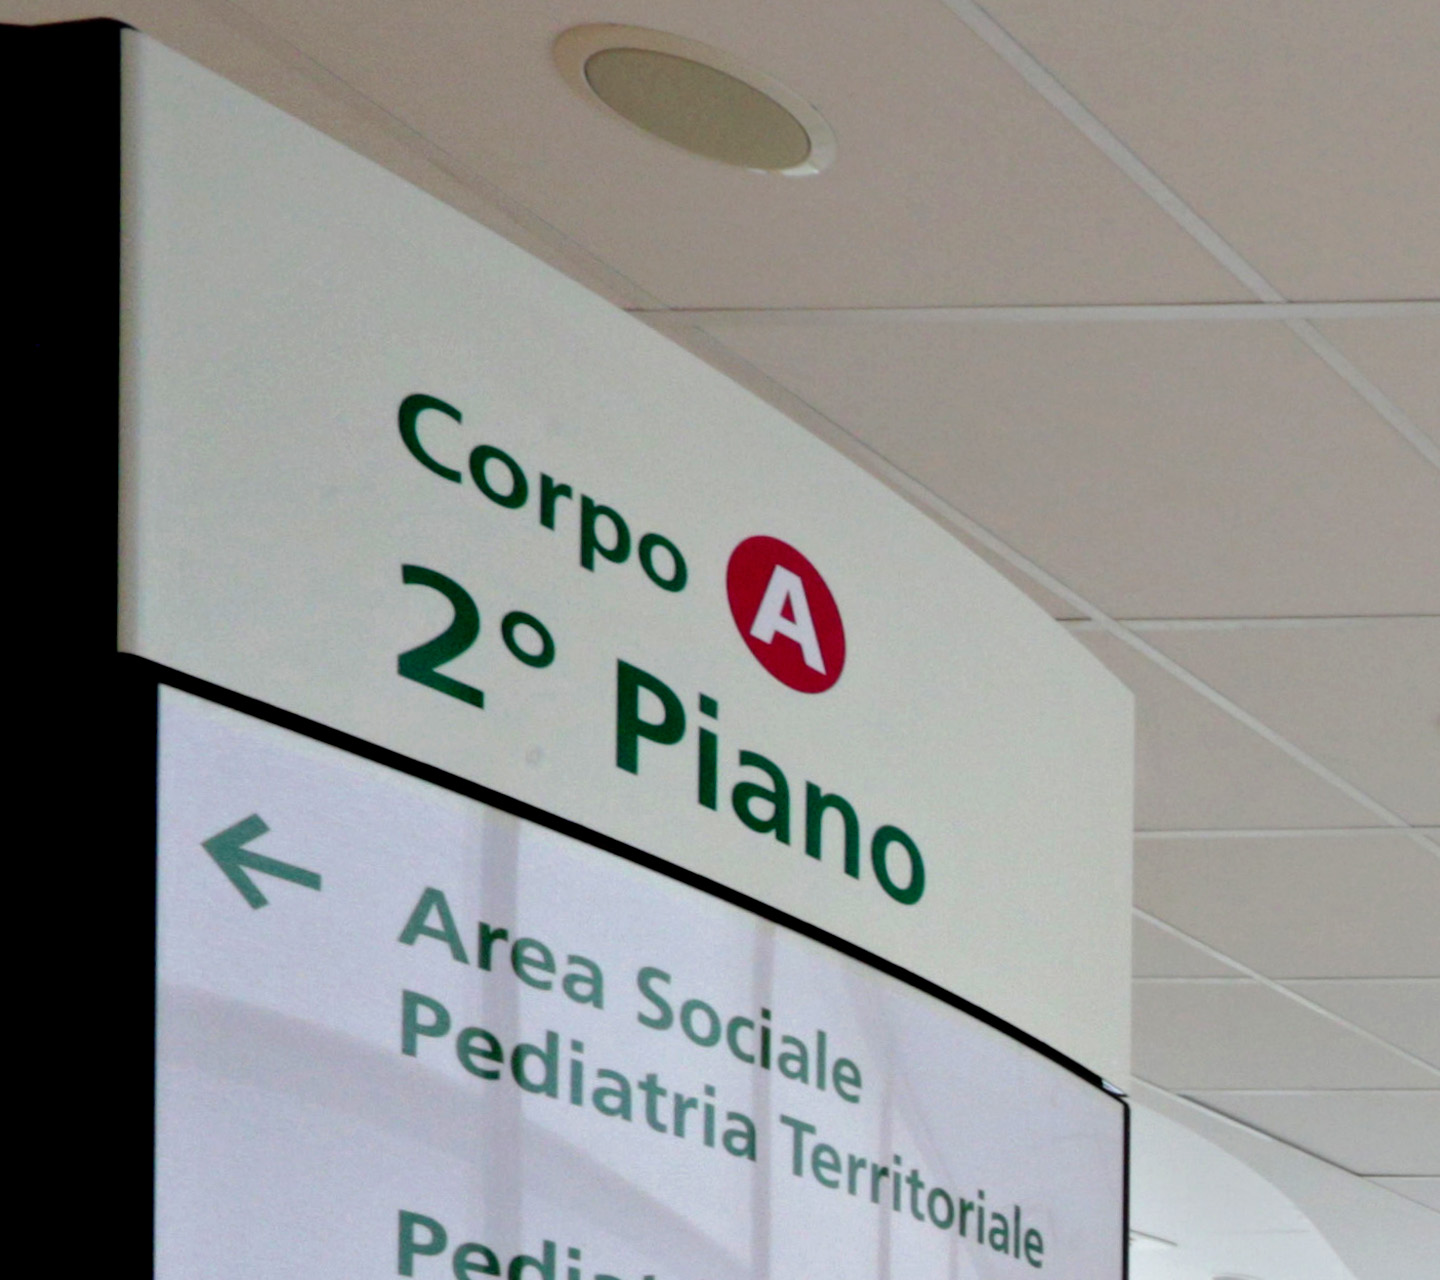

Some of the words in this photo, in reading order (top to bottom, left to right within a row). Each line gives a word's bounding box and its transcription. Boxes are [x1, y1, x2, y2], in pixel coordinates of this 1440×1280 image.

[397, 393, 689, 592] Corpo
[749, 563, 827, 676] A
[615, 658, 927, 906] Piano
[397, 887, 604, 1010] Area
[636, 965, 863, 1104] Sociale
[400, 989, 758, 1162] Pediatria
[780, 1115, 1045, 1270] Territoriale
